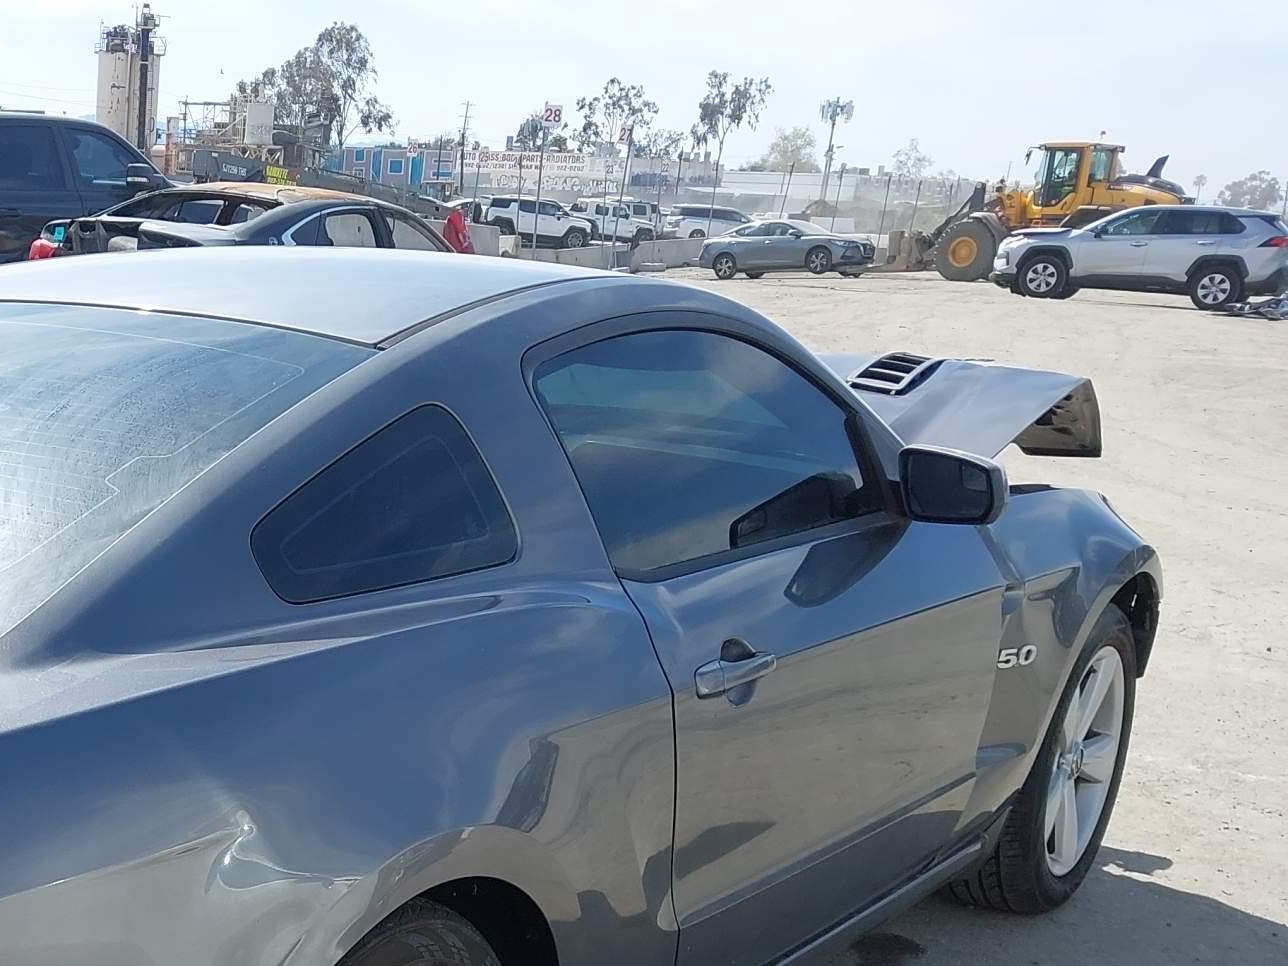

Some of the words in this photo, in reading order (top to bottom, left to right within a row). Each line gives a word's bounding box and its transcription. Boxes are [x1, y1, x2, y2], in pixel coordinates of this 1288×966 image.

[544, 108, 562, 123] 28
[619, 127, 632, 143] 27
[407, 142, 418, 153] 26
